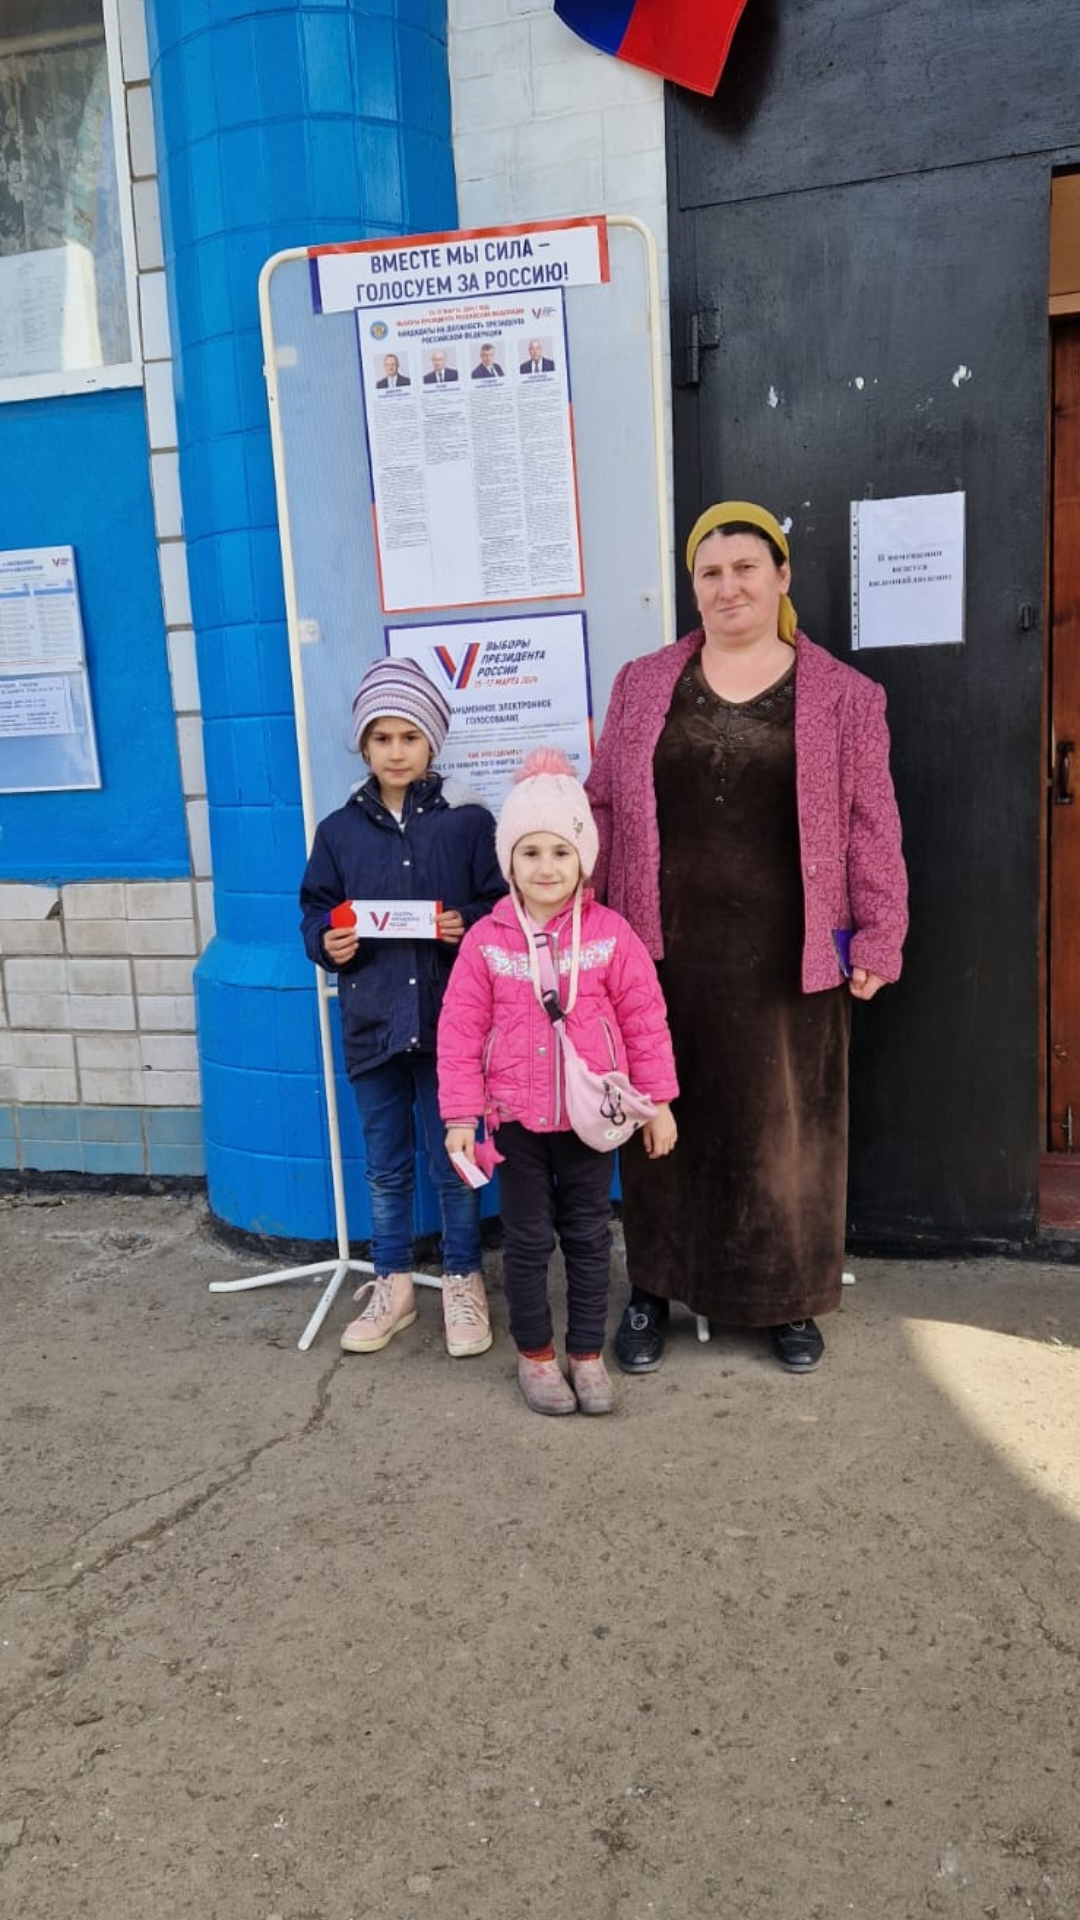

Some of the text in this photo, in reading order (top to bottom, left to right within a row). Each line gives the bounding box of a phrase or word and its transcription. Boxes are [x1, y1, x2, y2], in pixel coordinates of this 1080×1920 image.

[371, 249, 440, 274] ВМЕСТЕ
[446, 245, 479, 266] МЫ
[485, 238, 533, 261] СИЛА
[357, 262, 570, 303] ГОЛОСУЕМ ЗА РОССИЮ!
[486, 639, 531, 651] ВЫБОРЫ
[481, 650, 546, 664] ПРЕЗИДЕНТА
[477, 665, 519, 677] РОССИИ
[498, 699, 551, 712] ЭЛЕКТРОННОЕ
[465, 713, 519, 726] ГОЛОСОВАНИЕ
